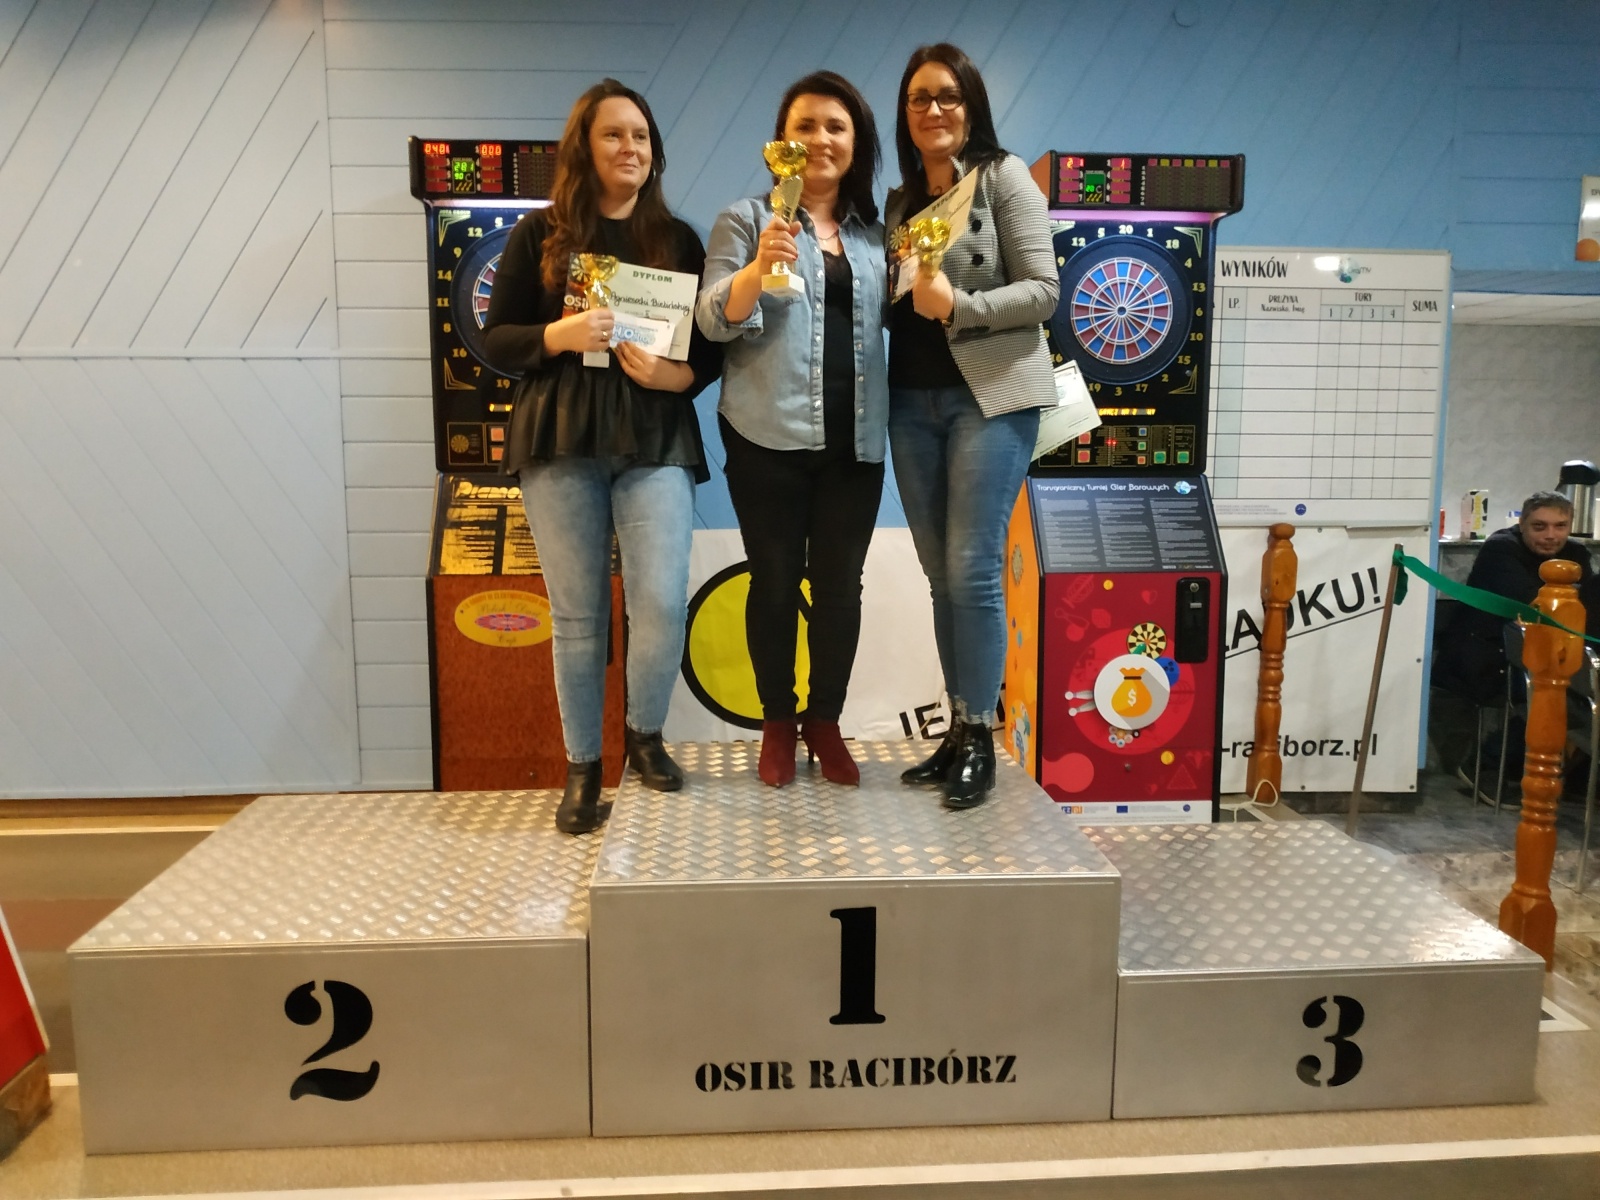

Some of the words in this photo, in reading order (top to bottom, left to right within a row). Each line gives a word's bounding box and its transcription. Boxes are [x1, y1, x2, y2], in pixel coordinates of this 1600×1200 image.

[495, 217, 503, 229] 5
[467, 227, 482, 237] 12
[1097, 228, 1105, 238] 5
[1119, 225, 1134, 235] 20
[1147, 228, 1154, 238] 1
[1071, 237, 1086, 247] 12
[1165, 239, 1180, 249] 18
[453, 247, 462, 258] 9
[1057, 257, 1065, 267] 9
[1184, 258, 1192, 268] 4
[1221, 256, 1288, 278] WYNIKÓW
[437, 270, 452, 282] 14
[632, 270, 673, 283] DYPLOM
[1192, 282, 1206, 292] 13
[1354, 292, 1372, 302] TORY
[436, 298, 449, 307] 11
[1412, 300, 1438, 312] SUMA
[1195, 308, 1203, 317] 6
[1329, 308, 1333, 317] 1
[1348, 308, 1353, 318] 2
[1370, 308, 1375, 318] 3
[1390, 309, 1396, 318] 4
[443, 323, 451, 333] 8
[1190, 332, 1204, 341] 10
[452, 348, 467, 358] 16
[1177, 355, 1191, 364] 15
[473, 366, 481, 377] 7
[1161, 374, 1169, 382] 2
[496, 379, 511, 389] 19
[1088, 383, 1101, 392] 19
[1135, 384, 1148, 393] 17
[1114, 387, 1122, 396] 3
[1086, 484, 1108, 492] Turniej
[1128, 484, 1170, 492] Barowych
[829, 906, 886, 1025] 1
[284, 979, 380, 1102] 2
[1296, 995, 1365, 1087] 3
[695, 1061, 796, 1092] OSIR
[808, 1048, 1017, 1090] RACIBÓRZ
